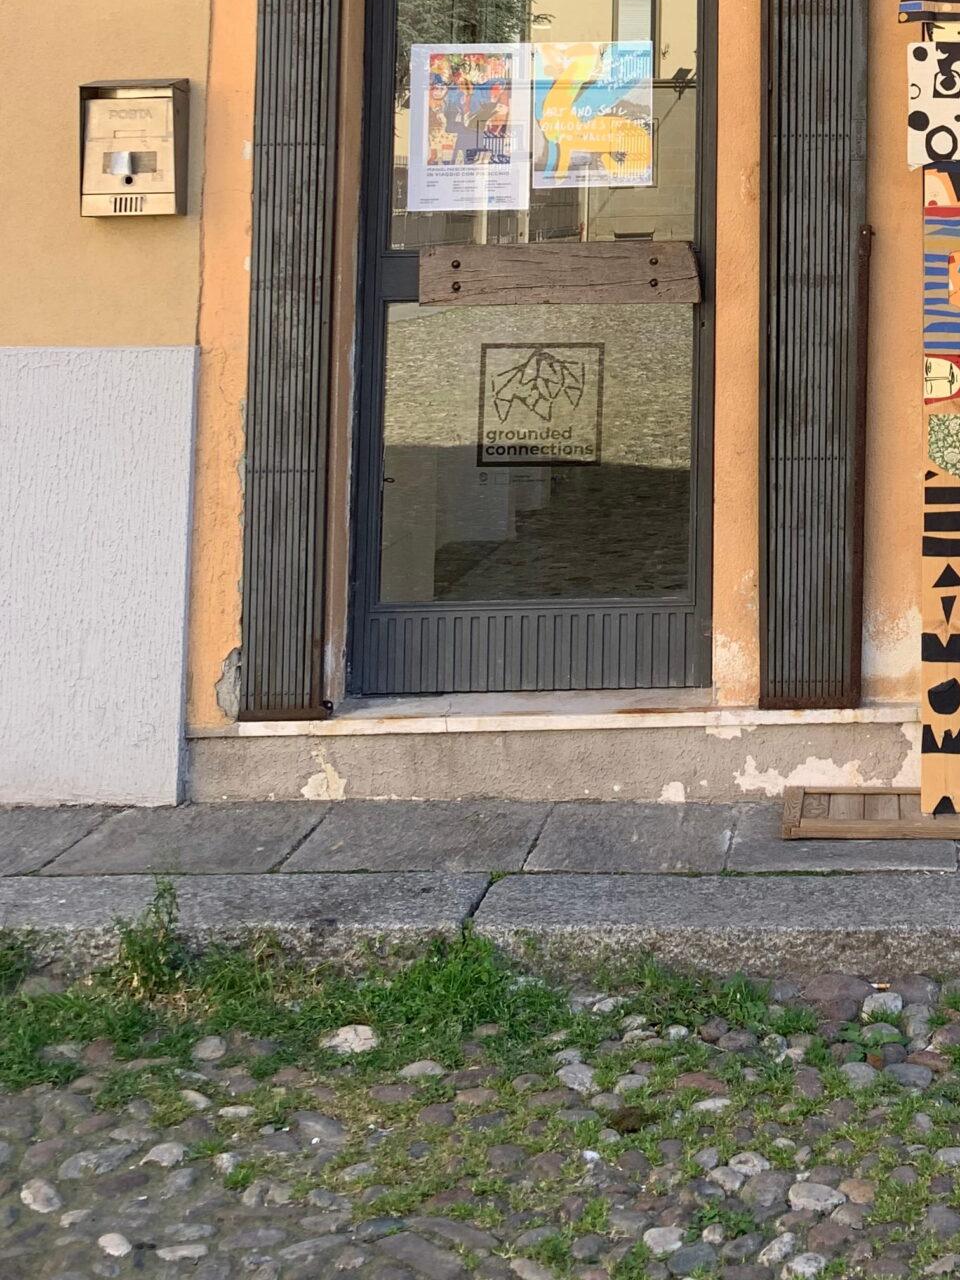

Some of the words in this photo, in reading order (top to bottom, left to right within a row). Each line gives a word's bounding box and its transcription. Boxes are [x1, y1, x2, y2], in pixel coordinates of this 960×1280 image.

[108, 108, 153, 120] POSTA
[544, 106, 564, 117] ART
[571, 105, 592, 117] AND
[540, 120, 606, 131] DIALOGUES
[486, 426, 573, 444] grounded
[485, 441, 594, 456] connections
